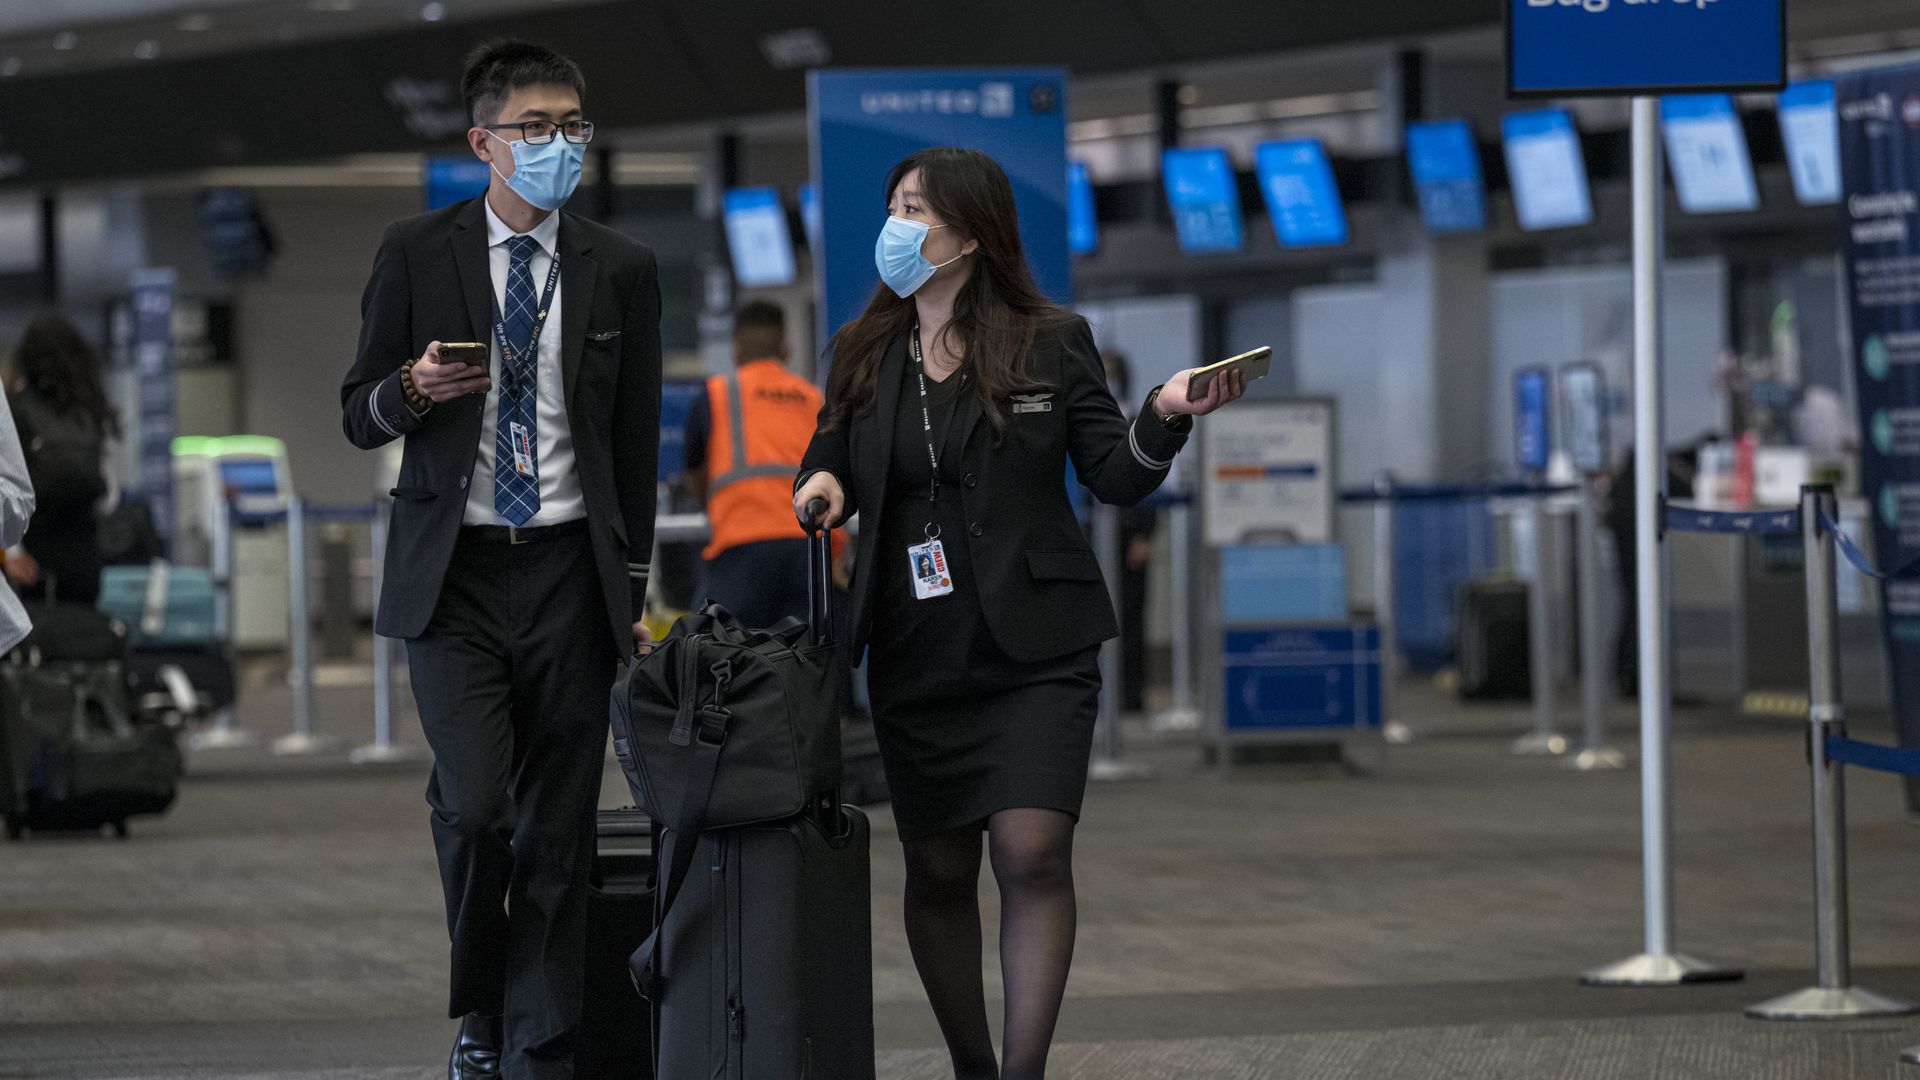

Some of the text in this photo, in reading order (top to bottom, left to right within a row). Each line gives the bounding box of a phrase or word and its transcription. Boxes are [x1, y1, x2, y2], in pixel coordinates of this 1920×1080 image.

[861, 90, 977, 114] UNITED
[547, 262, 559, 292] UNITED
[496, 322, 513, 360] We are SFO
[532, 325, 540, 340] SFO
[910, 547, 934, 557] UNITED
[933, 551, 945, 572] CREW
[922, 574, 943, 583] KAREN
